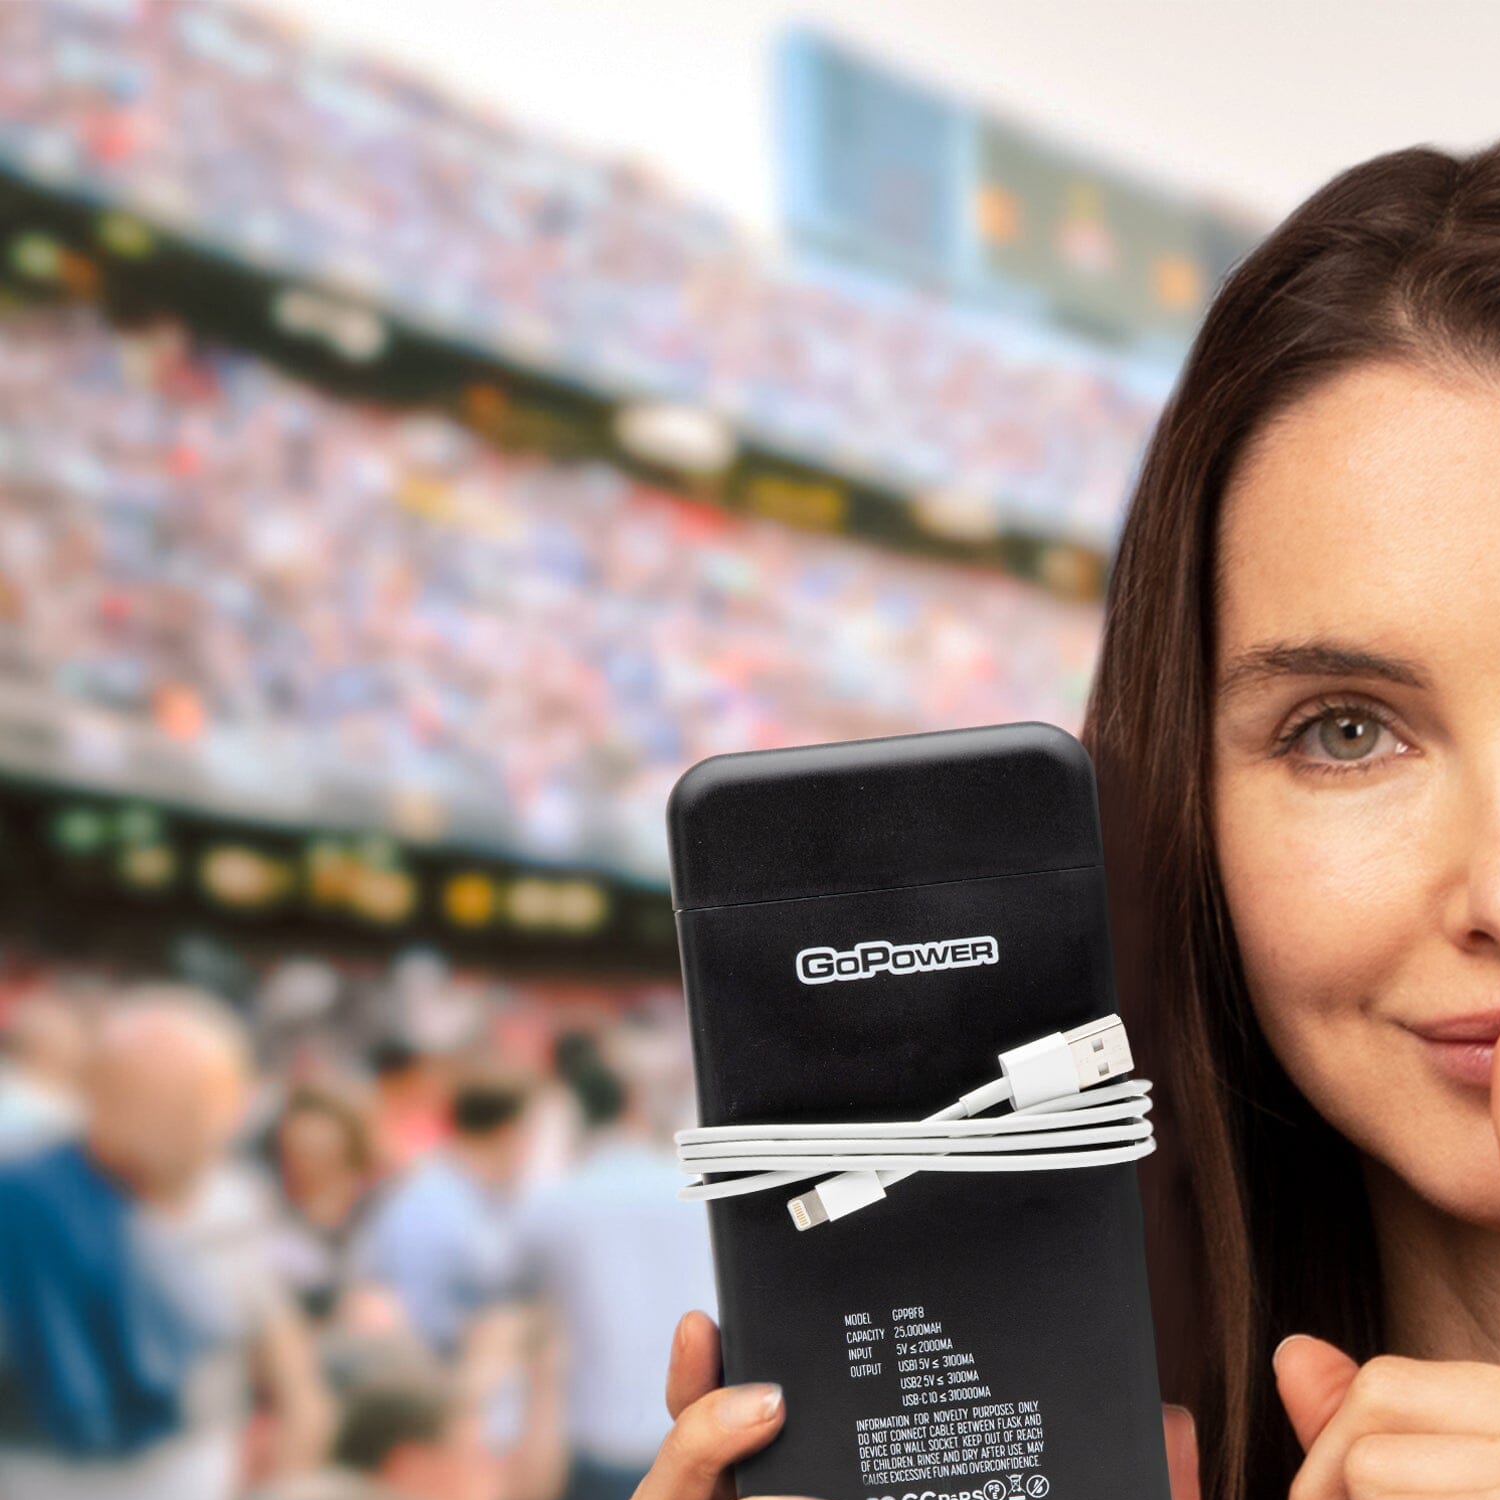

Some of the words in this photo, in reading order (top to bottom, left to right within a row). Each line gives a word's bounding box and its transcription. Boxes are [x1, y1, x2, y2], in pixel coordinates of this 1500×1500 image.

[845, 1313, 871, 1326] MODEL
[847, 1329, 884, 1343] CAPACITY
[849, 1347, 872, 1360] INPUT
[896, 1343, 907, 1355] 5V
[918, 1338, 953, 1352] 2000MA
[851, 1363, 881, 1377] OUTPUT
[919, 1358, 929, 1369] 5V
[943, 1353, 974, 1367] 3100MA
[901, 1376, 922, 1389] USB2
[924, 1375, 934, 1387] 5V
[947, 1370, 979, 1384] 3100MA
[902, 1392, 928, 1406] USB-C
[929, 1391, 938, 1403] 10
[856, 1415, 910, 1432] INFORMATION
[914, 1413, 929, 1424] FOR
[934, 1409, 968, 1422] NOVELTY
[973, 1403, 1014, 1418] PURPOSES
[858, 1433, 869, 1445] DO
[872, 1431, 887, 1443] NOT
[890, 1426, 926, 1441] CONNECT
[929, 1423, 955, 1437] CABLE
[957, 1419, 995, 1434] BETWEEN
[997, 1416, 1022, 1429] FLASK
[1025, 1414, 1041, 1426] AND
[859, 1444, 888, 1459] DEVICE
[890, 1443, 901, 1455] OR
[903, 1441, 926, 1453] WALL
[962, 1434, 982, 1447] KEEP
[985, 1432, 1000, 1444] OUT
[1004, 1430, 1013, 1442] OF
[1017, 1428, 1043, 1440] REACH
[861, 1460, 870, 1472] OF
[917, 1452, 941, 1466] RINSE
[943, 1450, 960, 1463] AND
[962, 1448, 978, 1461] DRY
[981, 1445, 1005, 1459] AFTER
[1027, 1441, 1044, 1453] MAY
[863, 1472, 889, 1484] CAUSE
[890, 1467, 932, 1483] EXCESSIVE
[933, 1465, 949, 1478] FUN
[951, 1463, 968, 1475] AND
